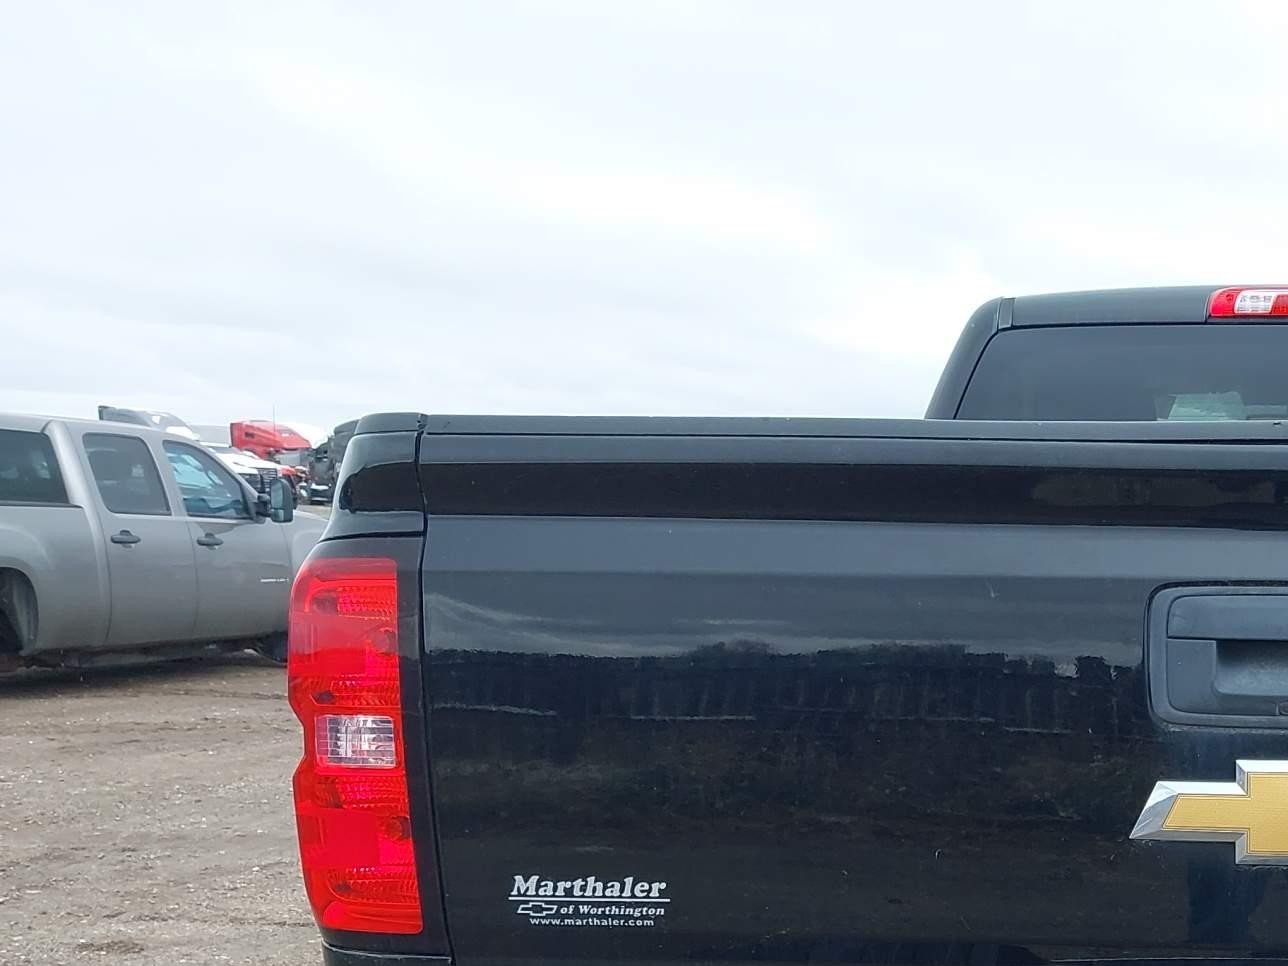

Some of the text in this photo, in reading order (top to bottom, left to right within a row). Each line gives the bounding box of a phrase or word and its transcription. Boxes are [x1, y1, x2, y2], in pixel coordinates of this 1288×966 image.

[510, 875, 667, 897] Marthaler
[560, 905, 665, 917] of Worthington
[529, 917, 655, 927] www.marthaler.com
